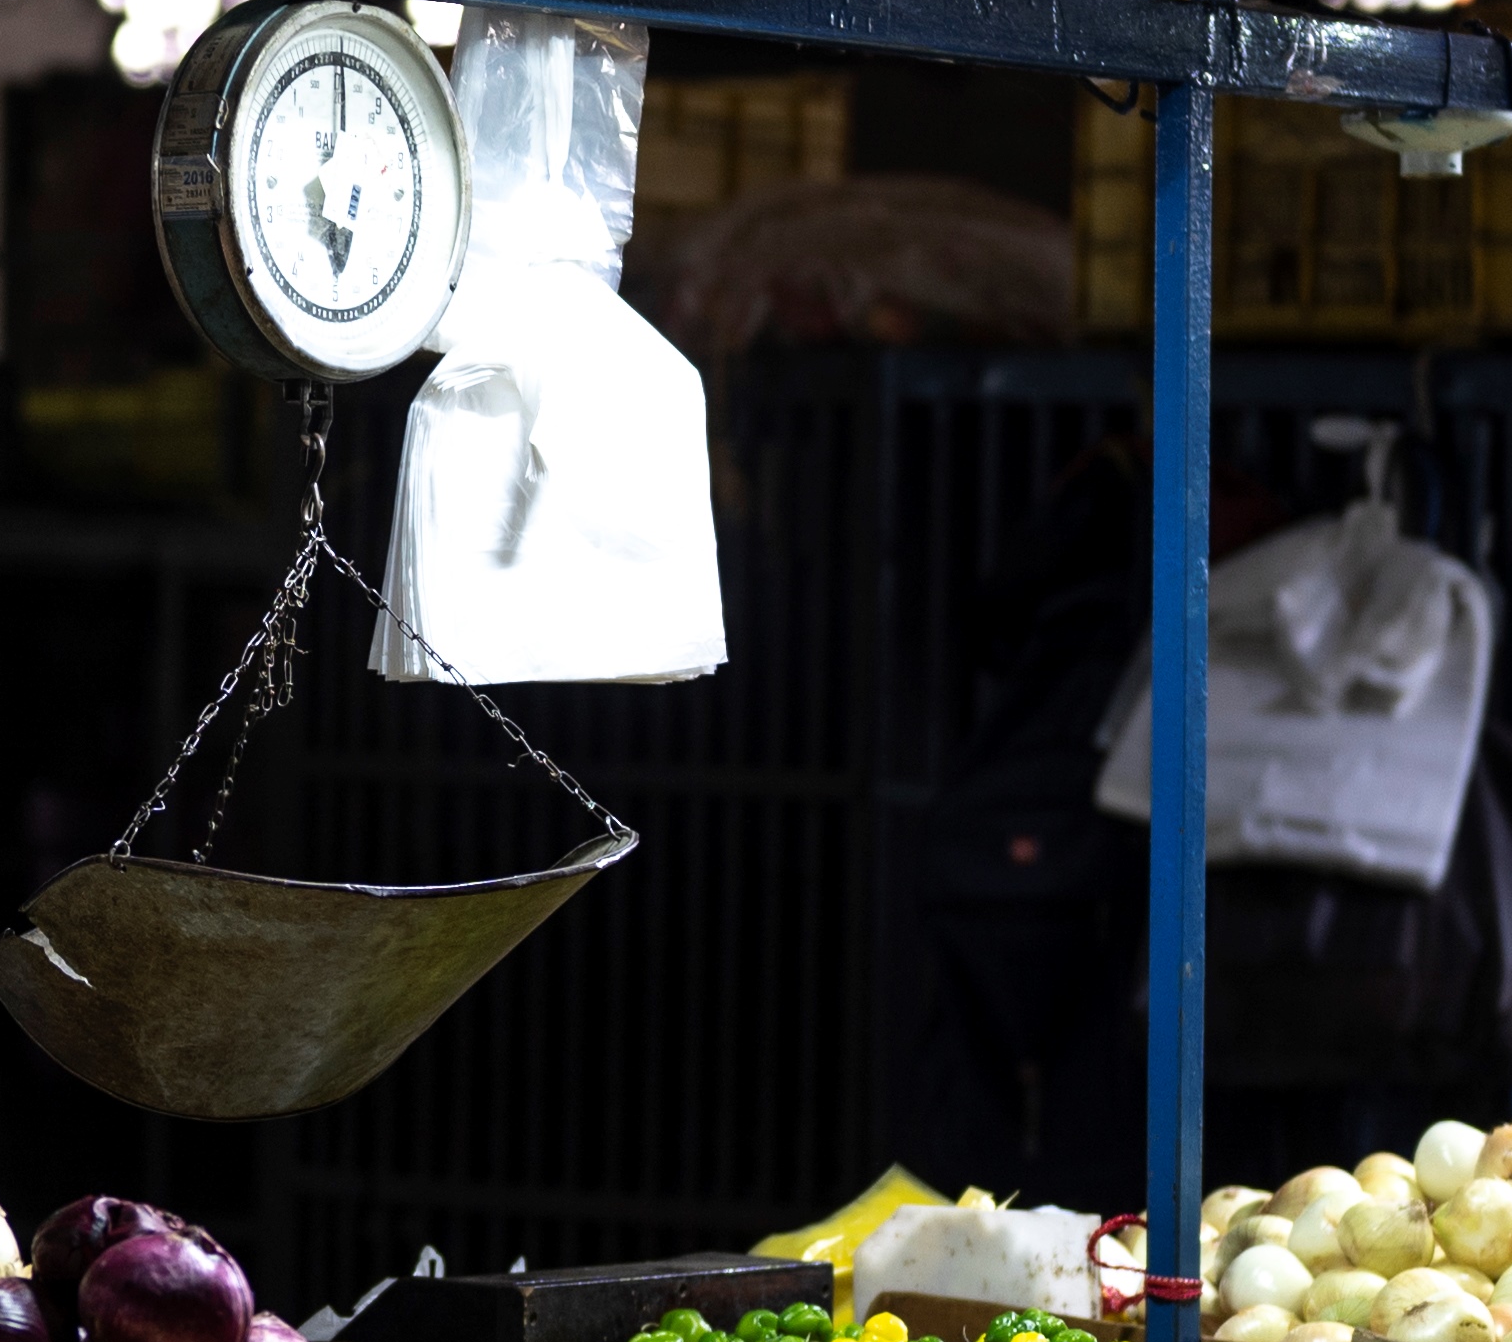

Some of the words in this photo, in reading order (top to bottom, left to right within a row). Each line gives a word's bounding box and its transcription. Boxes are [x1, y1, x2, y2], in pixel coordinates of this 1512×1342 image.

[375, 97, 382, 115] 9
[397, 152, 404, 169] 8
[184, 170, 214, 185] 2016
[267, 206, 273, 223] 3
